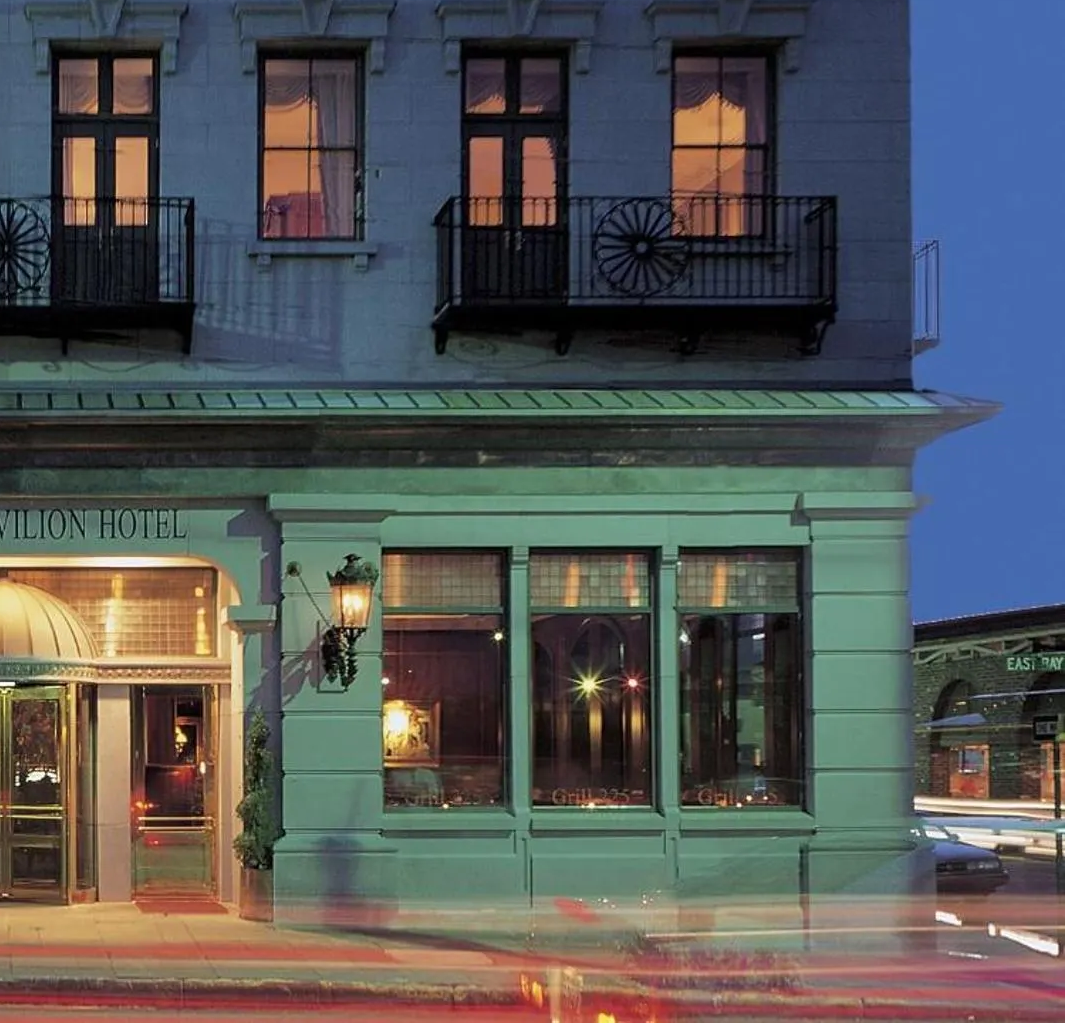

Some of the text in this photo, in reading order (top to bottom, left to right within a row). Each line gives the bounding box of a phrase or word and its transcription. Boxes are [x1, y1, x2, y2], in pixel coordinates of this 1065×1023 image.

[99, 508, 188, 540] HOTEL
[1006, 657, 1037, 672] EAST
[552, 788, 591, 805] Grill
